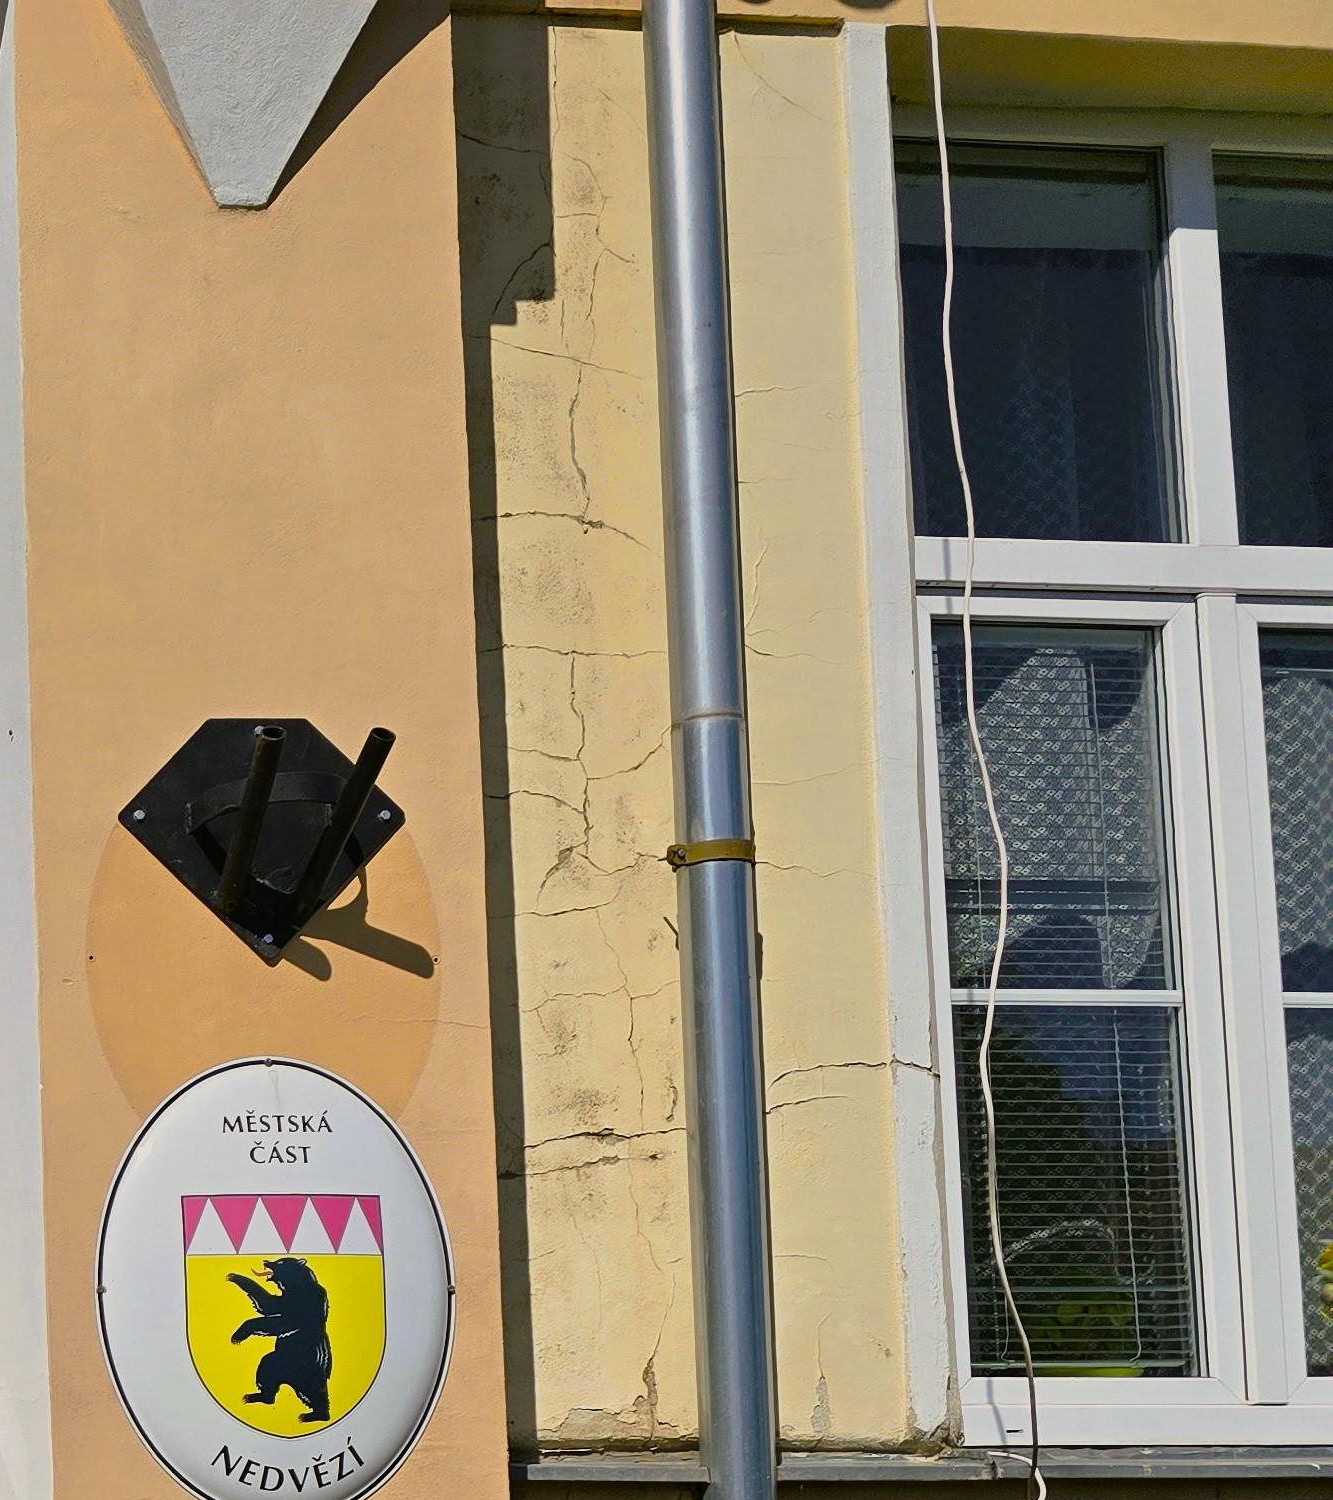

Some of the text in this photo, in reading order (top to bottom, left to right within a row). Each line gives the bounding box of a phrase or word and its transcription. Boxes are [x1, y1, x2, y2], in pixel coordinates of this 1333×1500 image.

[222, 1110, 333, 1134] MĚSTSKÁ
[249, 1140, 312, 1165] ČÁST
[211, 1436, 366, 1493] NEDVĚZÍ
